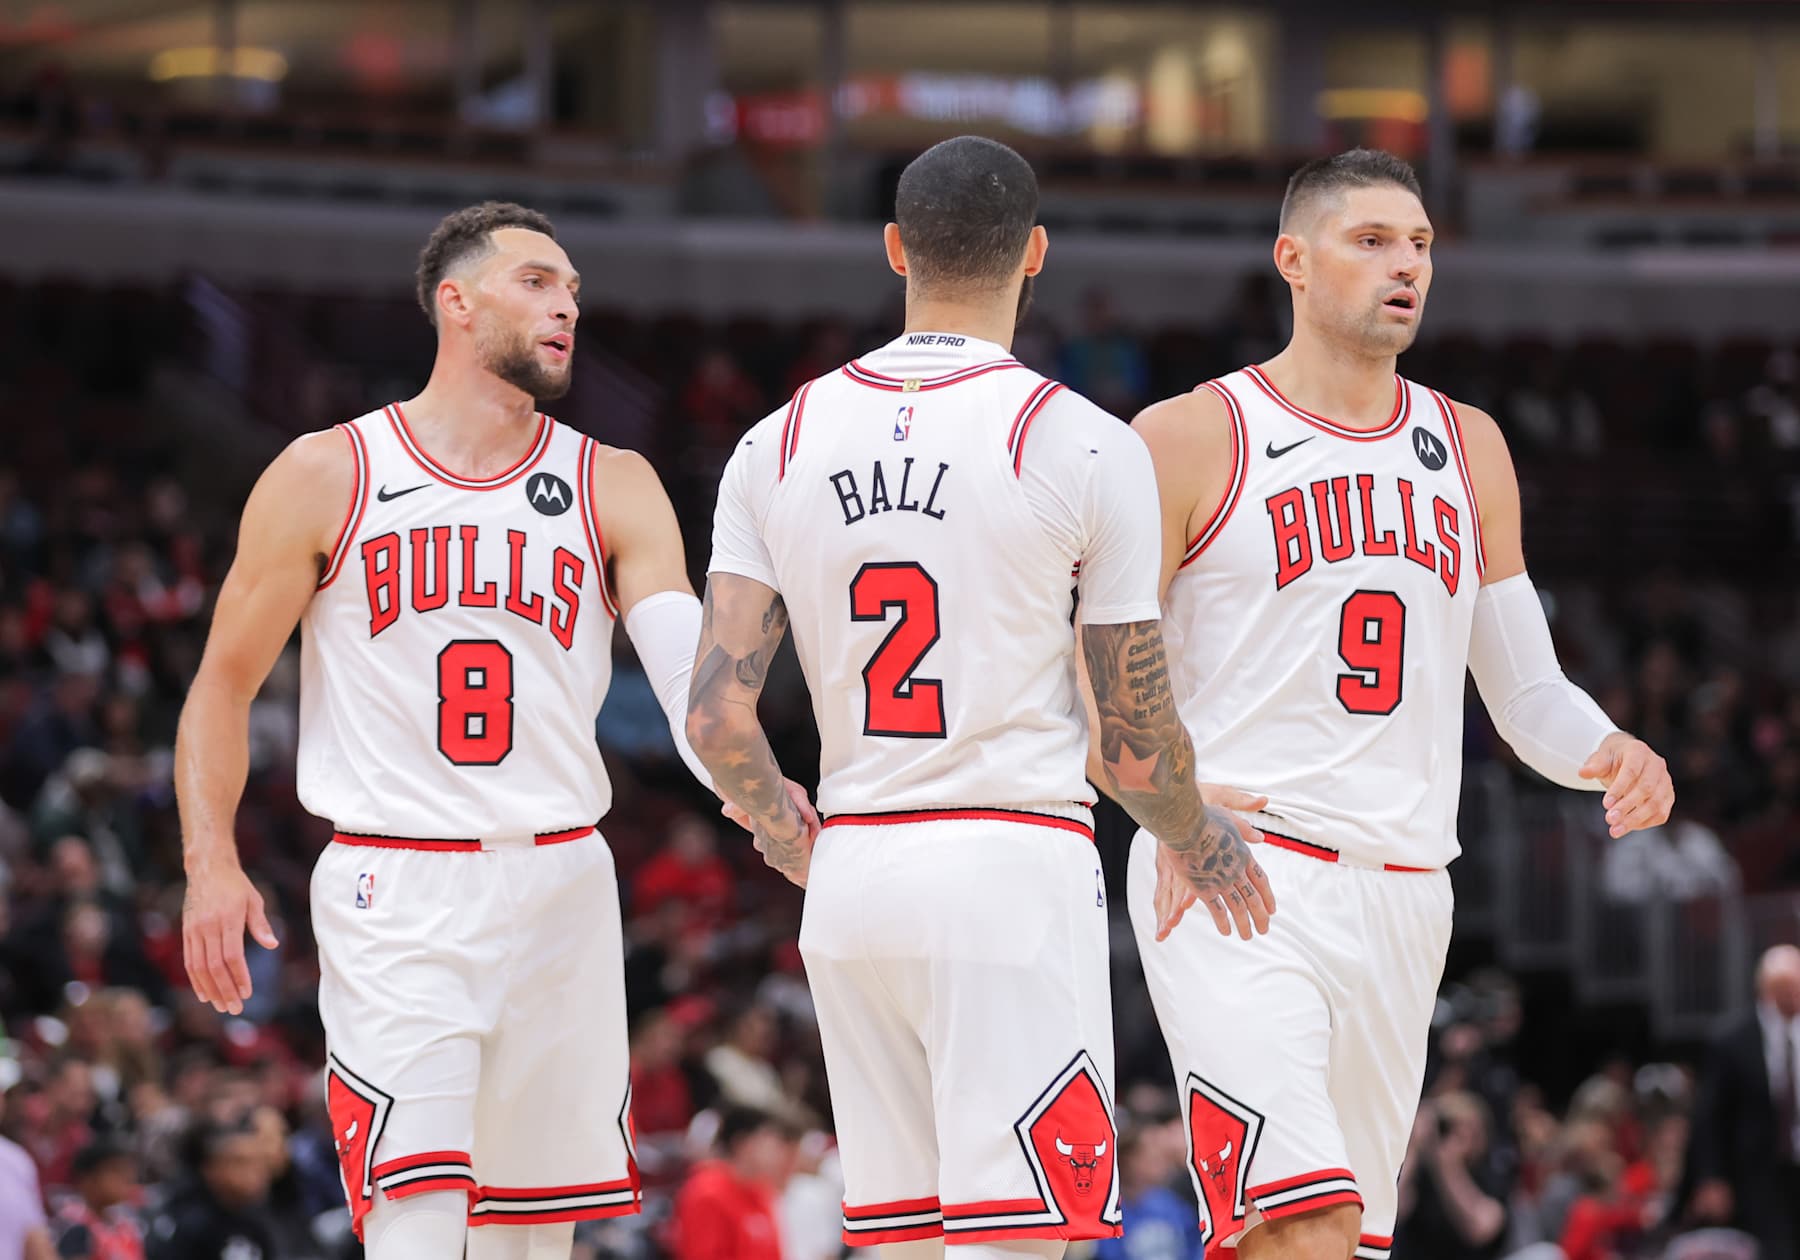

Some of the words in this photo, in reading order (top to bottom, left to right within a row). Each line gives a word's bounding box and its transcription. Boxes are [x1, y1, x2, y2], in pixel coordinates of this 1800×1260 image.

[905, 335, 936, 346] NIKE
[936, 335, 966, 347] PRO
[829, 457, 949, 526] BALL
[1265, 474, 1460, 597] BULLS
[361, 525, 585, 651] BULLS
[849, 561, 947, 739] 2
[437, 639, 513, 766] 8
[1336, 589, 1406, 716] 9
